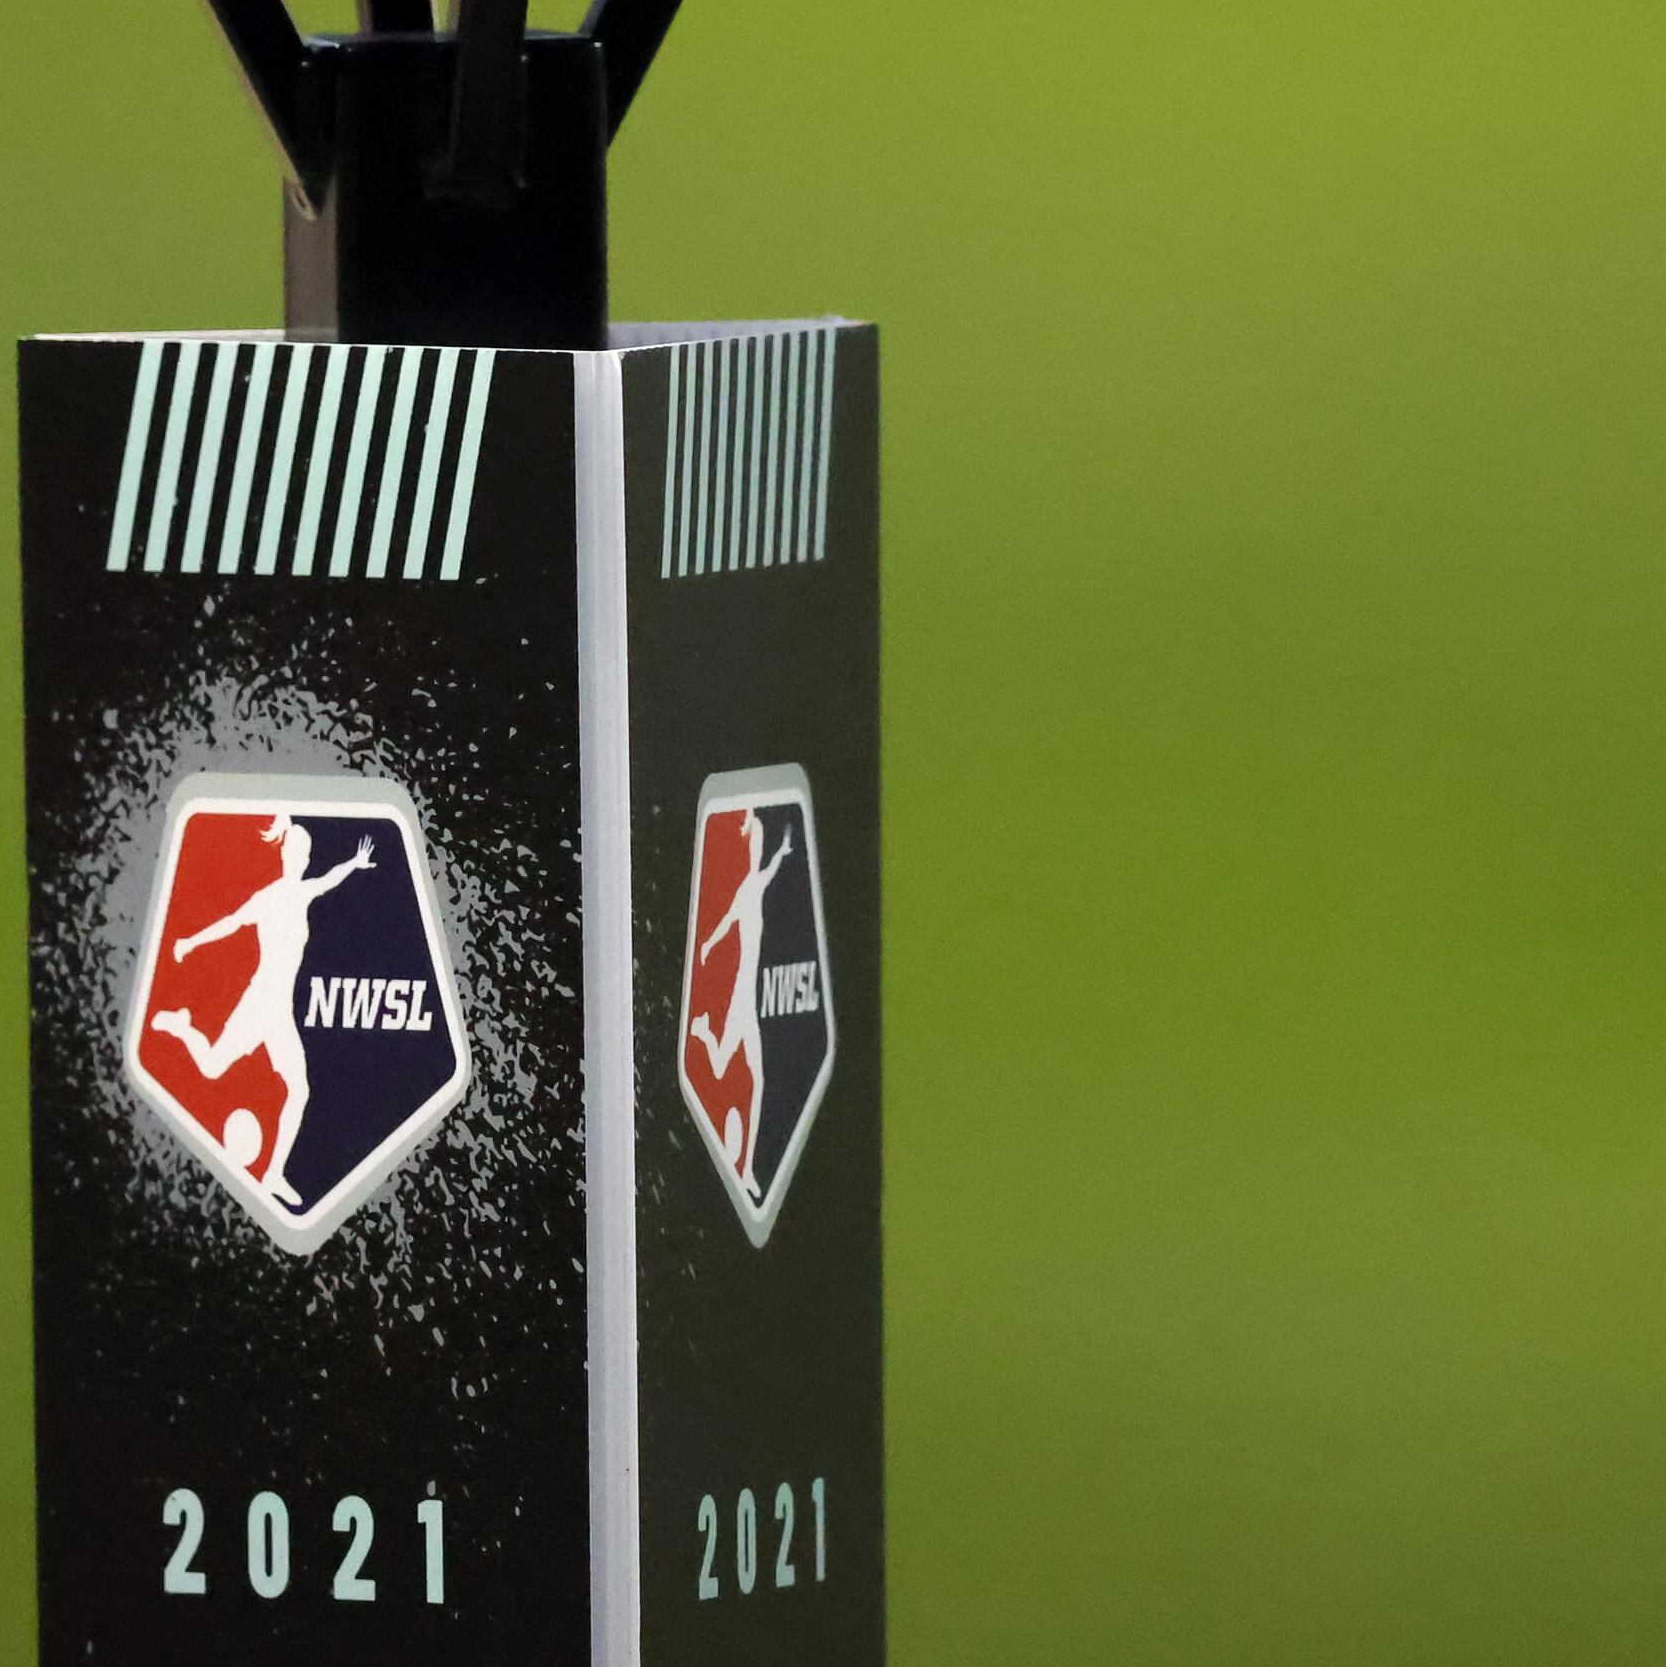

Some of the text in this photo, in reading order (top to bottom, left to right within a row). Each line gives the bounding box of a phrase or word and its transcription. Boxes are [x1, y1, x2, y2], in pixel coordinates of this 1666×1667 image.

[304, 976, 434, 1031] NWSL
[760, 961, 820, 1018] NWSL
[162, 1488, 445, 1604] 2021
[697, 1476, 827, 1601] 2021
